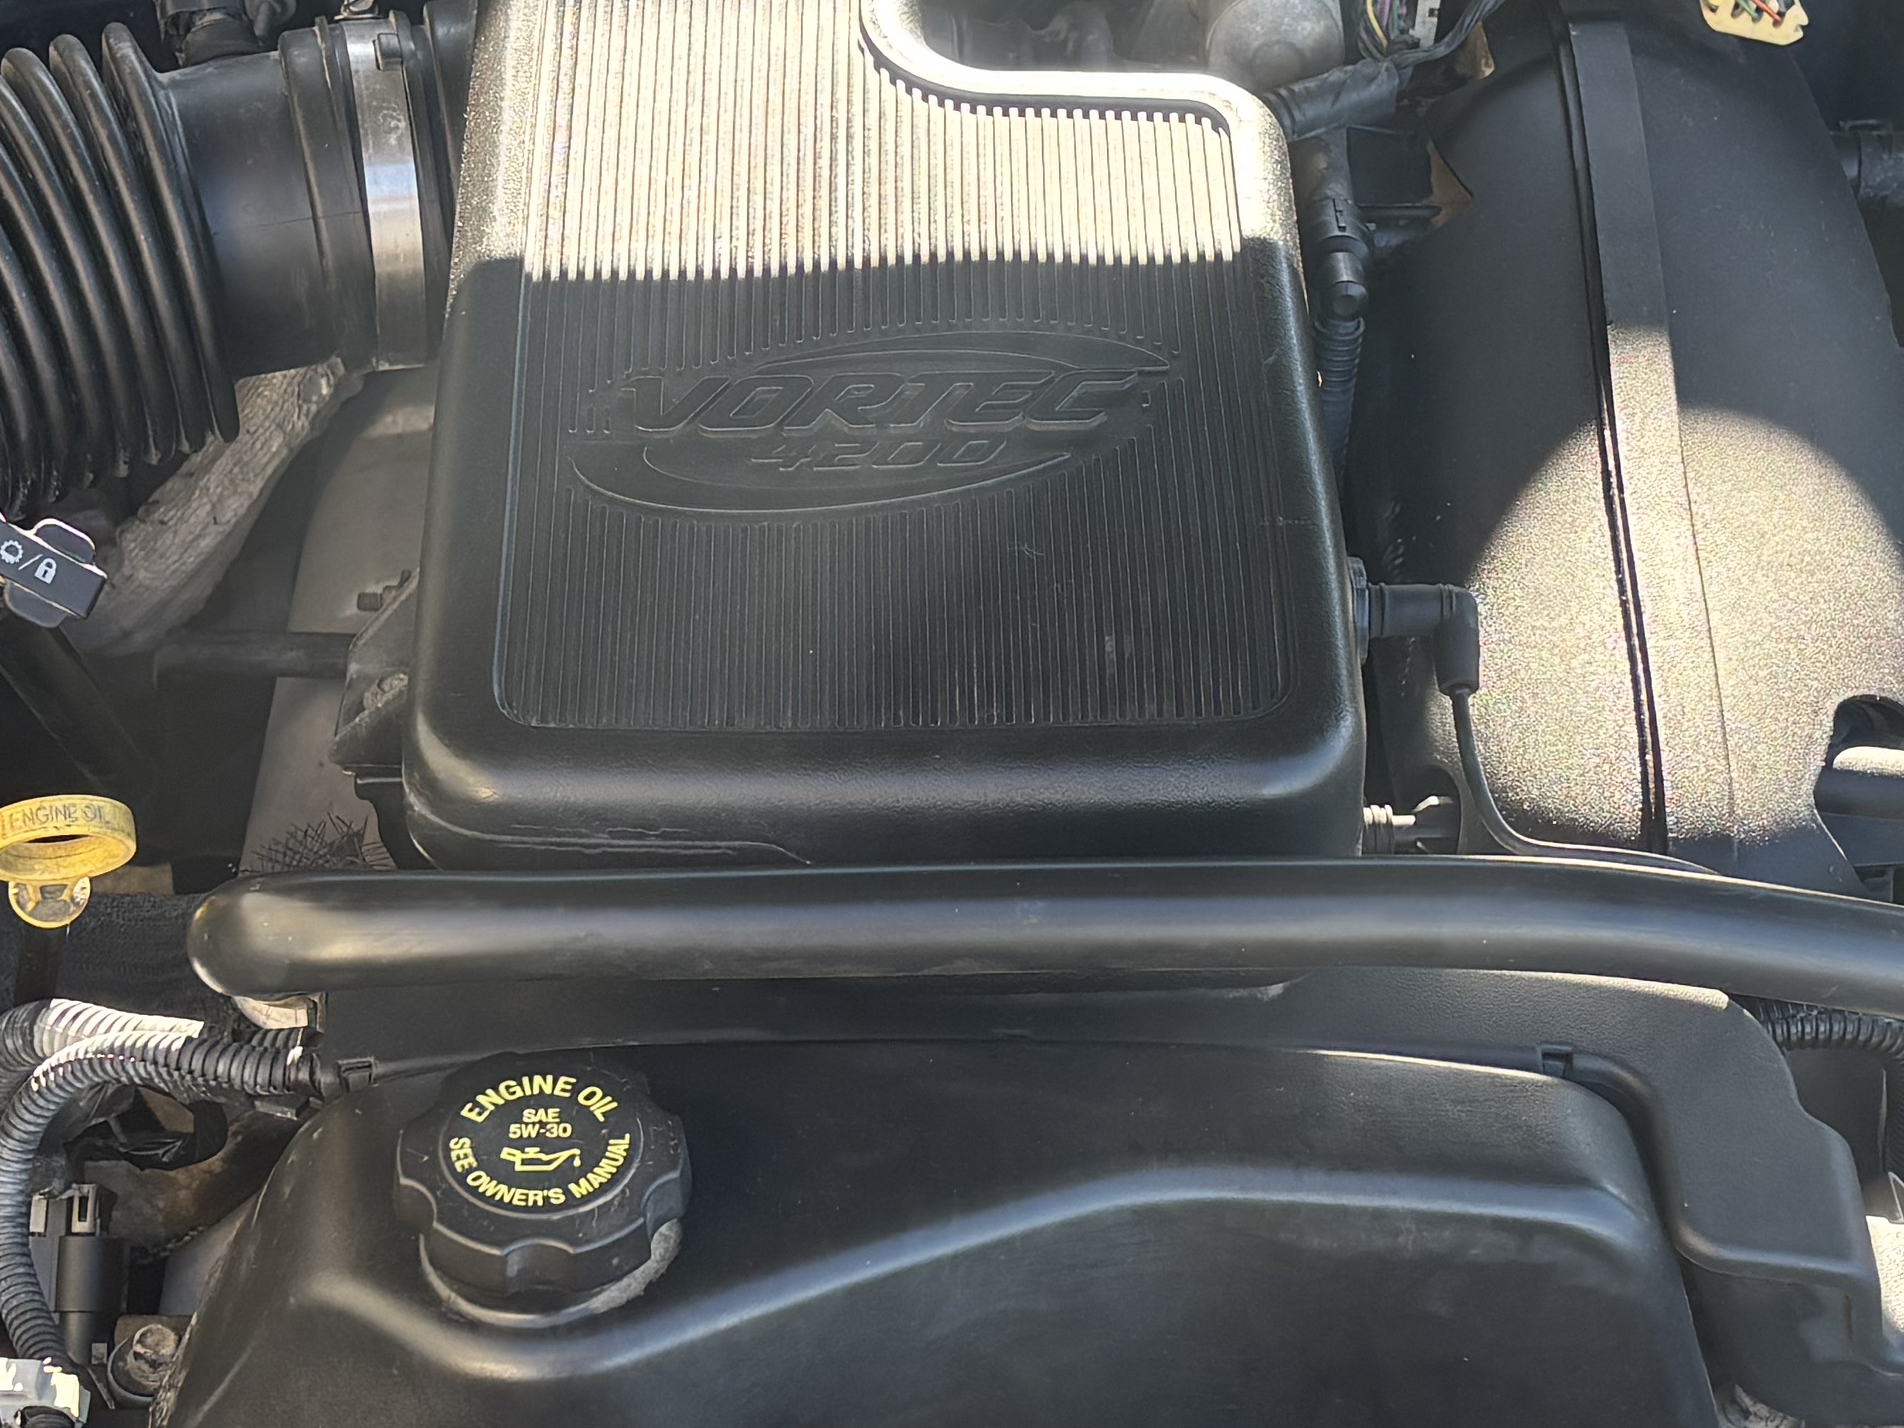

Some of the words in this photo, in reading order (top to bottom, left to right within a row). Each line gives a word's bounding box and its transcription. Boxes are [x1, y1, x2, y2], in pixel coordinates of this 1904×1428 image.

[618, 369, 1144, 439] VORTEC
[751, 437, 1007, 472] 4200
[10, 803, 78, 830] ENGINE
[82, 803, 111, 824] OIL
[460, 1074, 577, 1123] ENGINE
[577, 1086, 619, 1122] OIL
[522, 1108, 561, 1123] SAE
[508, 1124, 572, 1139] 5W-30
[449, 1136, 478, 1173] SEE
[466, 1170, 566, 1207] OWNER'S
[568, 1133, 631, 1198] MANUAL
